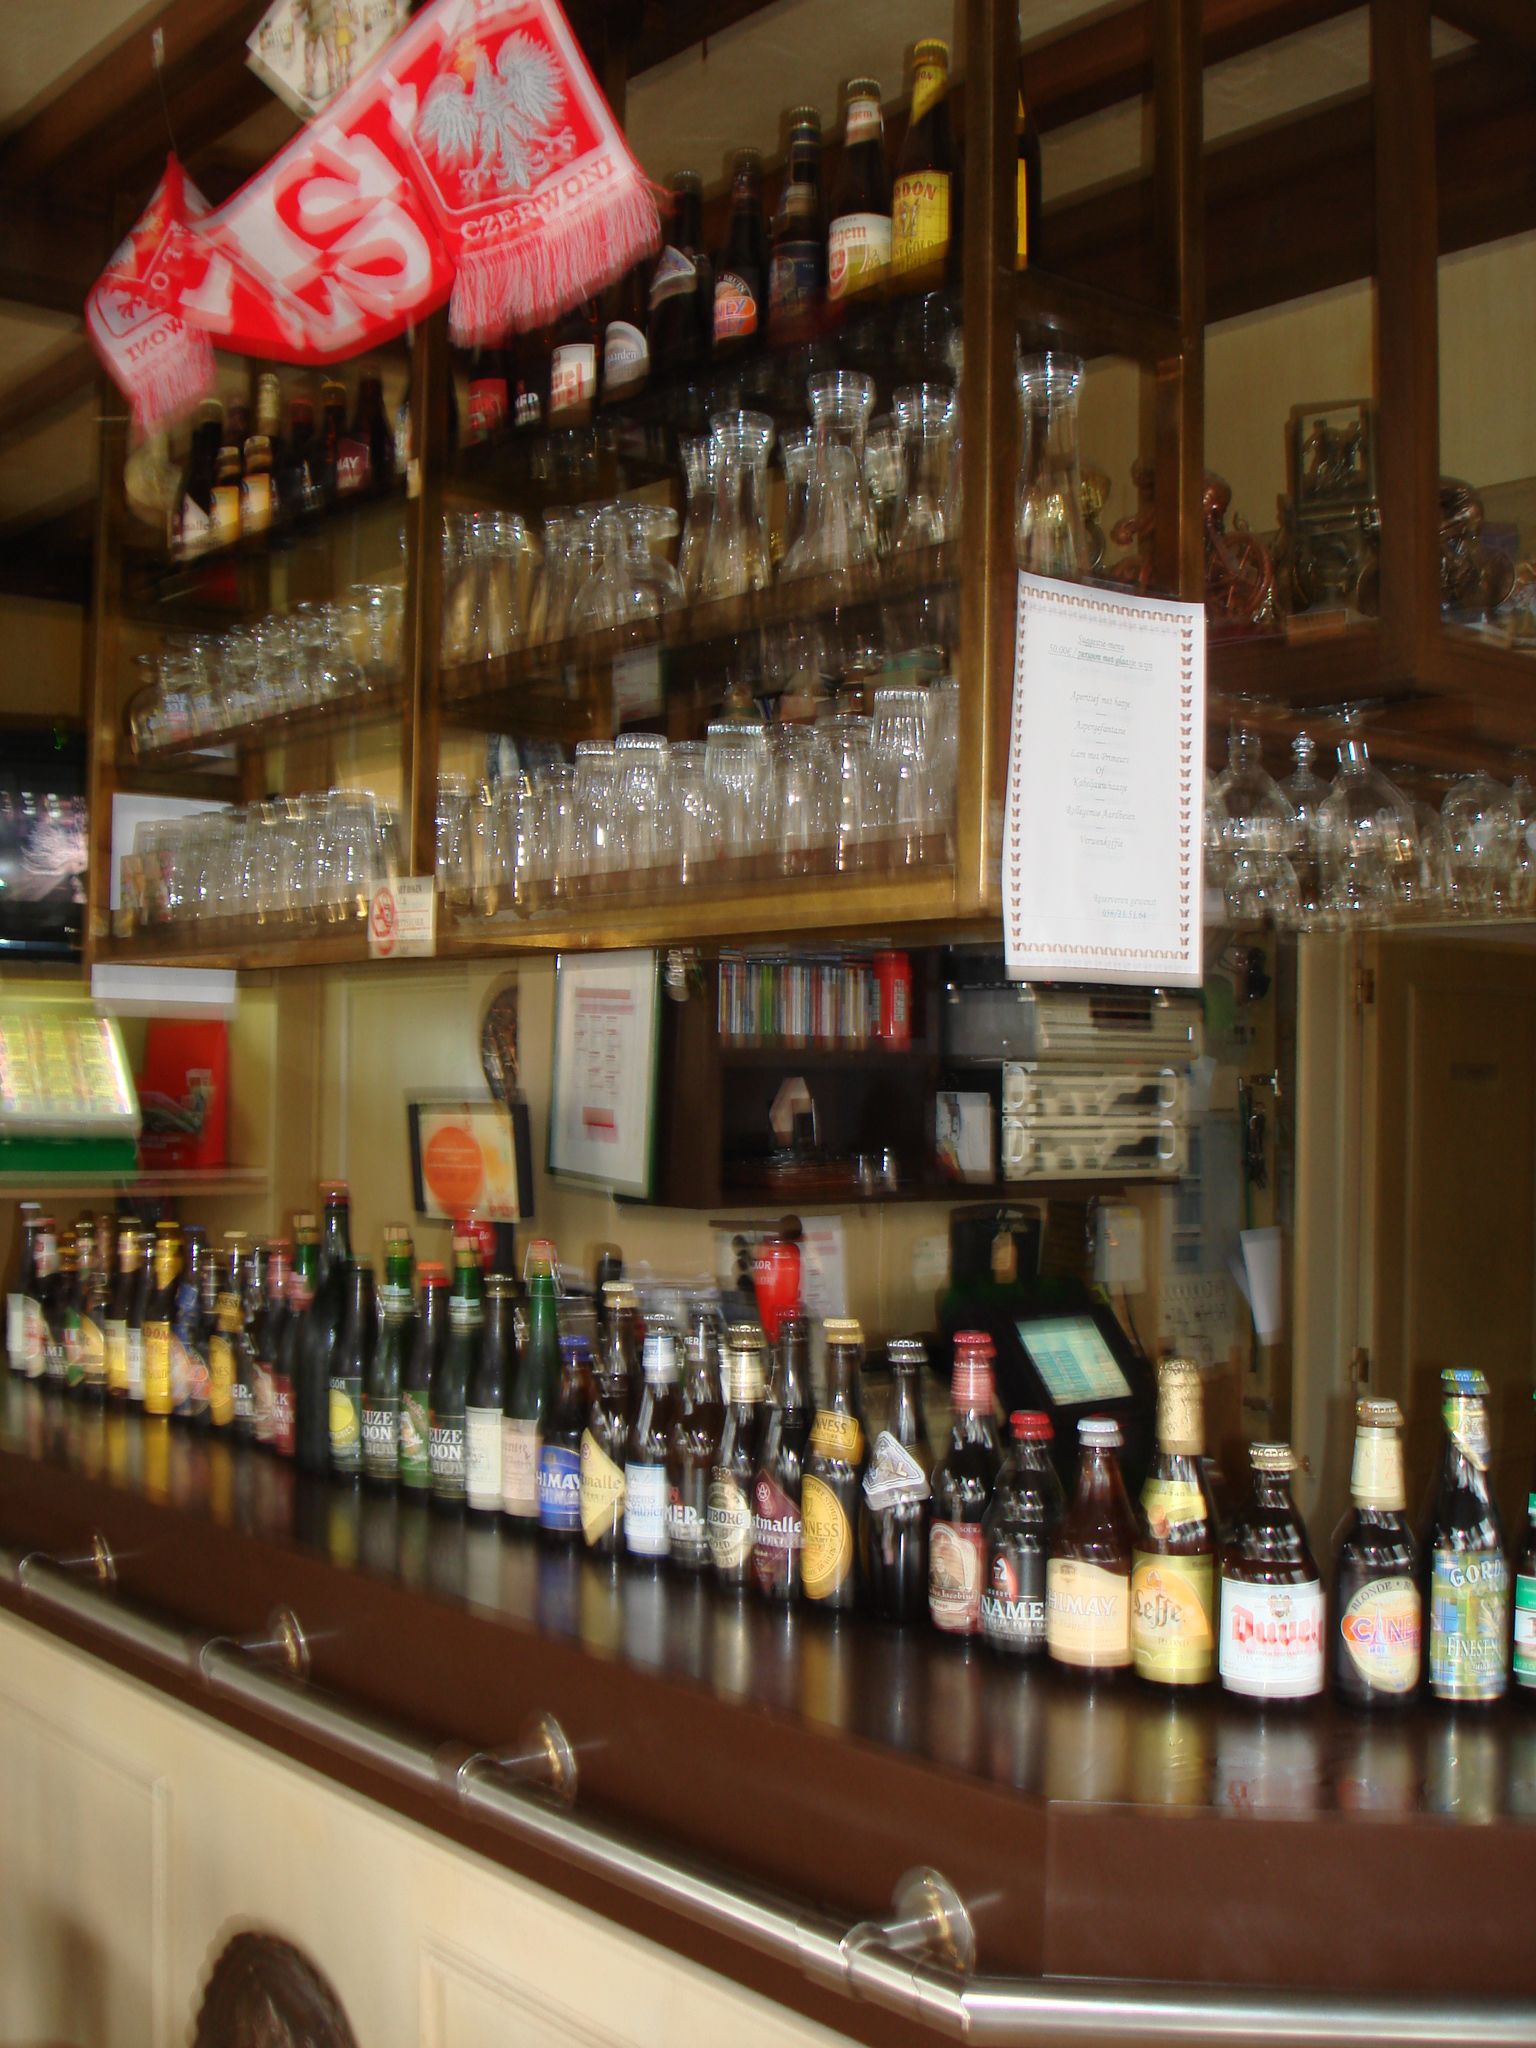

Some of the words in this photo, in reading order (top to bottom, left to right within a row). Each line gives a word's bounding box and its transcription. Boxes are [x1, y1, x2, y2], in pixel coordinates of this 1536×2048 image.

[458, 153, 617, 243] CZERWONI
[361, 1426, 393, 1440] OON
[429, 1444, 461, 1460] OON
[1134, 1590, 1182, 1629] Leffe
[1351, 1581, 1392, 1612] BLONDE
[1231, 1603, 1319, 1646] Duvel
